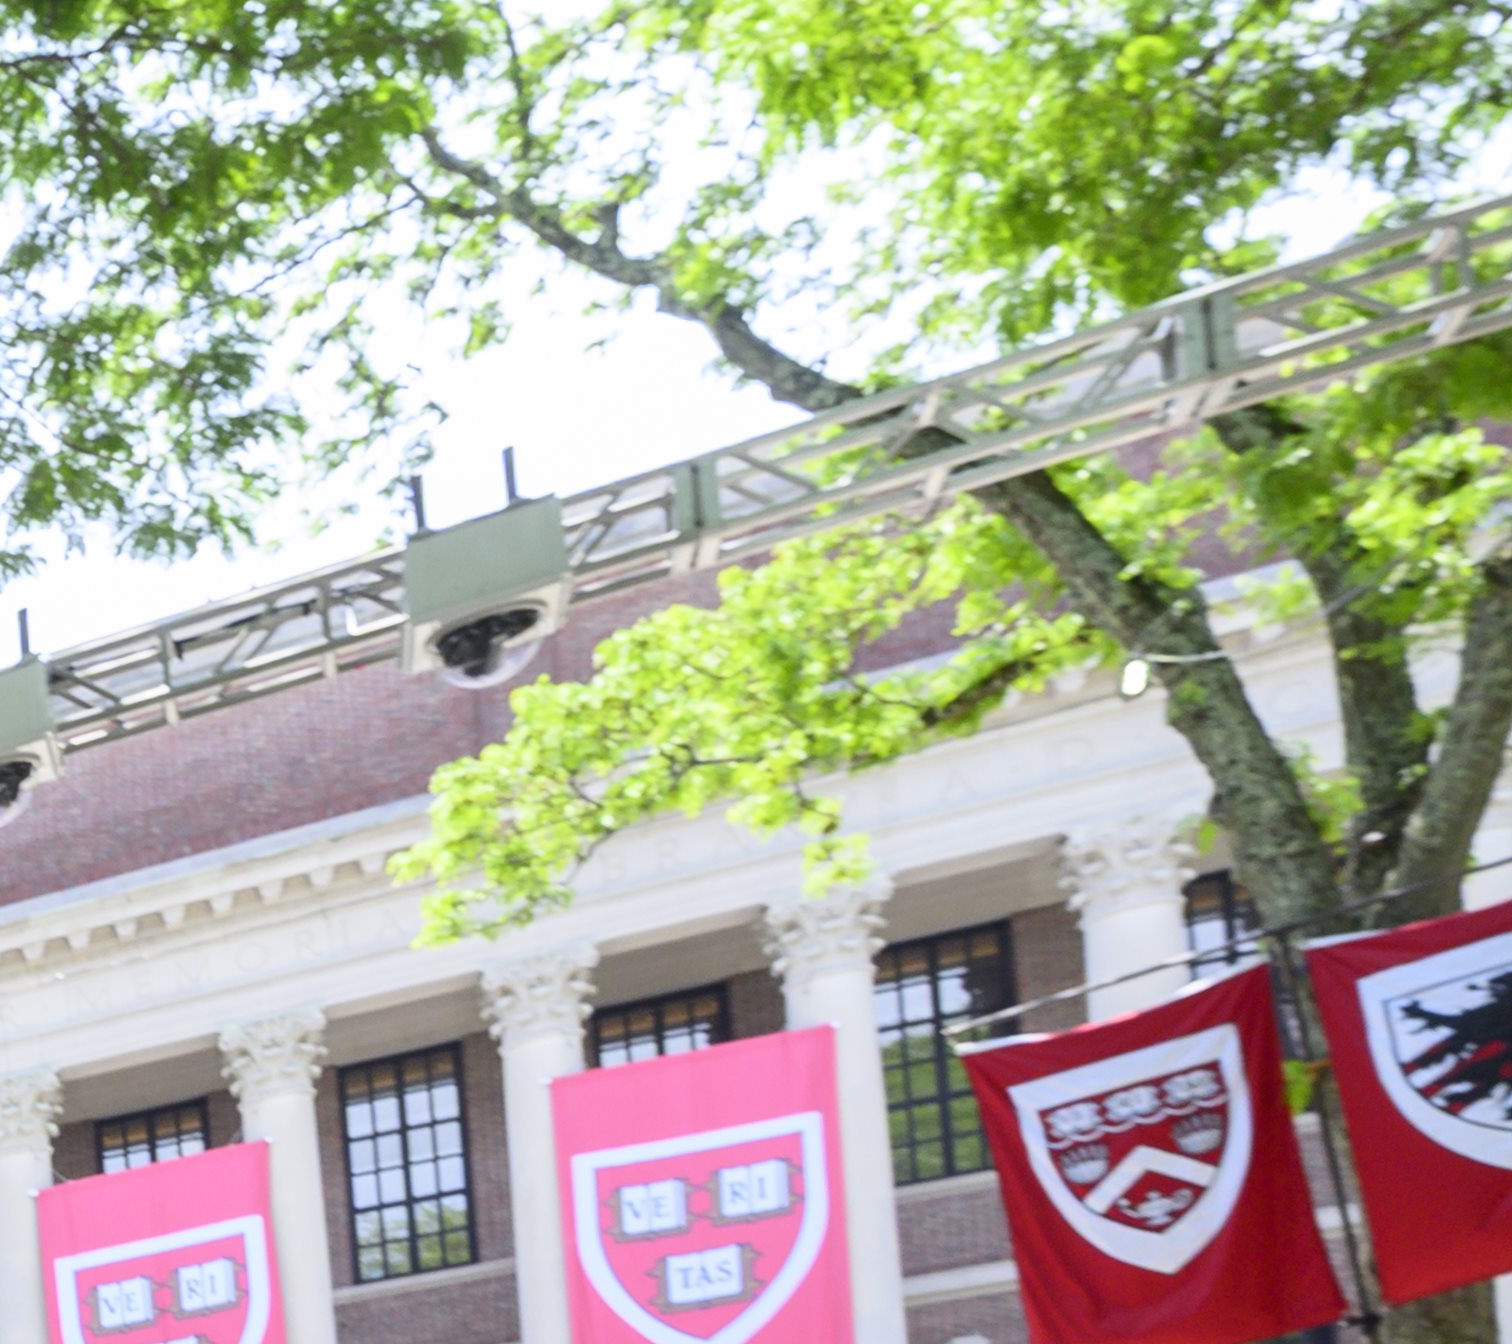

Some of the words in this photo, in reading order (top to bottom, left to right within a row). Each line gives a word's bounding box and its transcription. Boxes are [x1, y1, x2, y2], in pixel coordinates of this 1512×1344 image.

[73, 910, 409, 1013] MEMORIA
[627, 1197, 669, 1219] VE
[729, 1177, 766, 1204] RI
[103, 1292, 139, 1314] VE
[185, 1274, 217, 1300] RI
[677, 1261, 733, 1289] TAS
